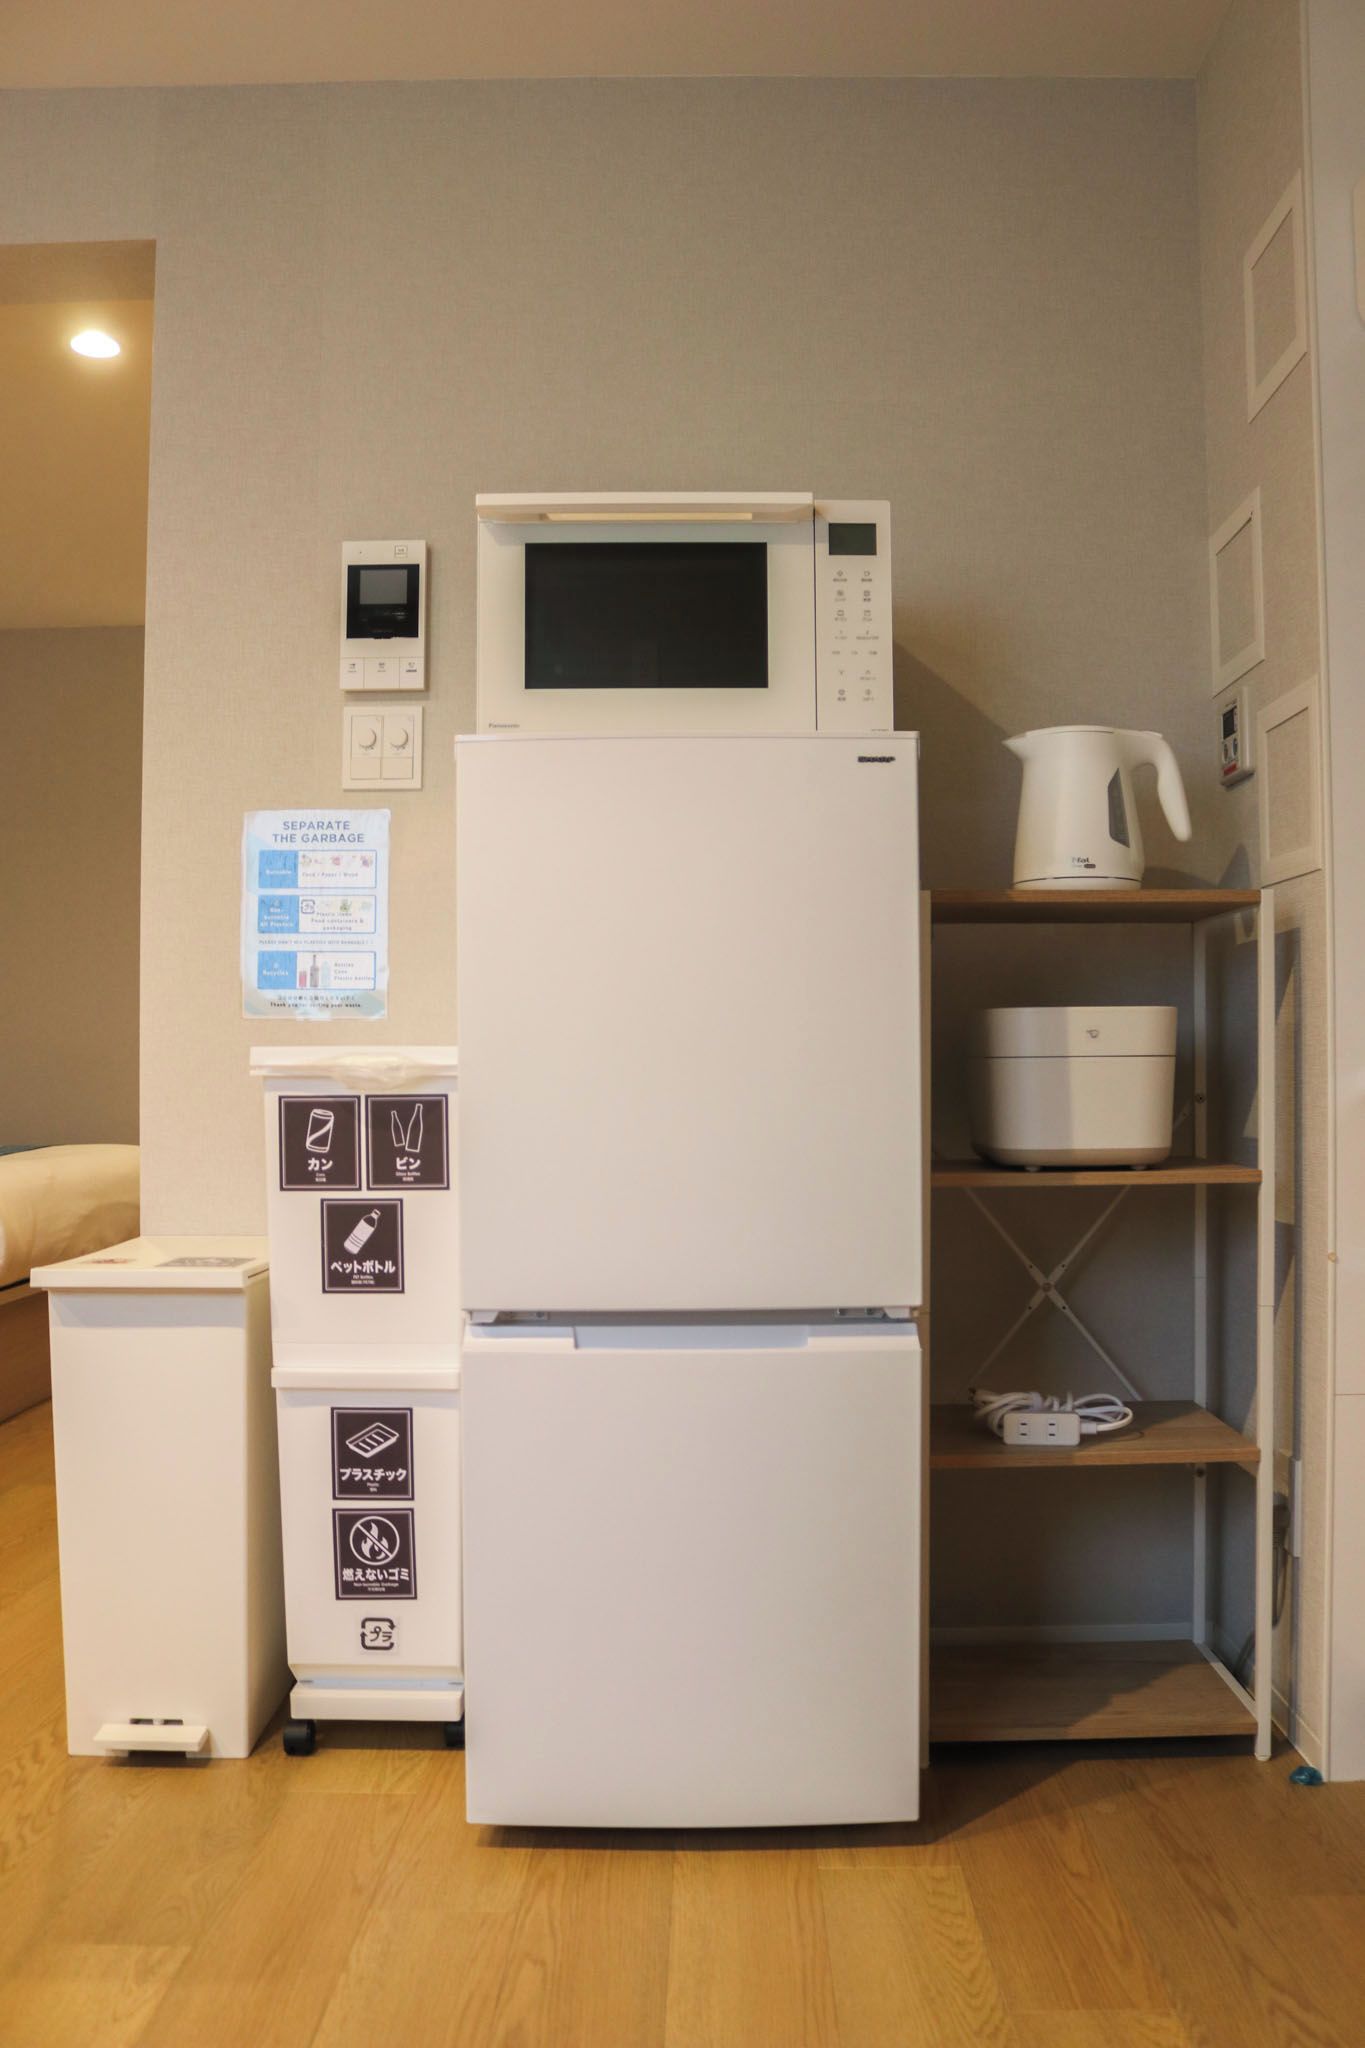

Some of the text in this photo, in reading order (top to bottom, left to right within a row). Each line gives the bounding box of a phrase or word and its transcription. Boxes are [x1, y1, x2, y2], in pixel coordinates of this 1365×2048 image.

[282, 820, 351, 831] SEPARATE
[272, 833, 365, 843] THE GARBAGE
[307, 1157, 333, 1171] カン
[395, 1156, 421, 1170] ビン
[330, 1260, 396, 1274] ペットボトル
[339, 1467, 407, 1481] プラスチック
[342, 1567, 410, 1581] 燃えないゴミ
[370, 1625, 393, 1642] プラ
